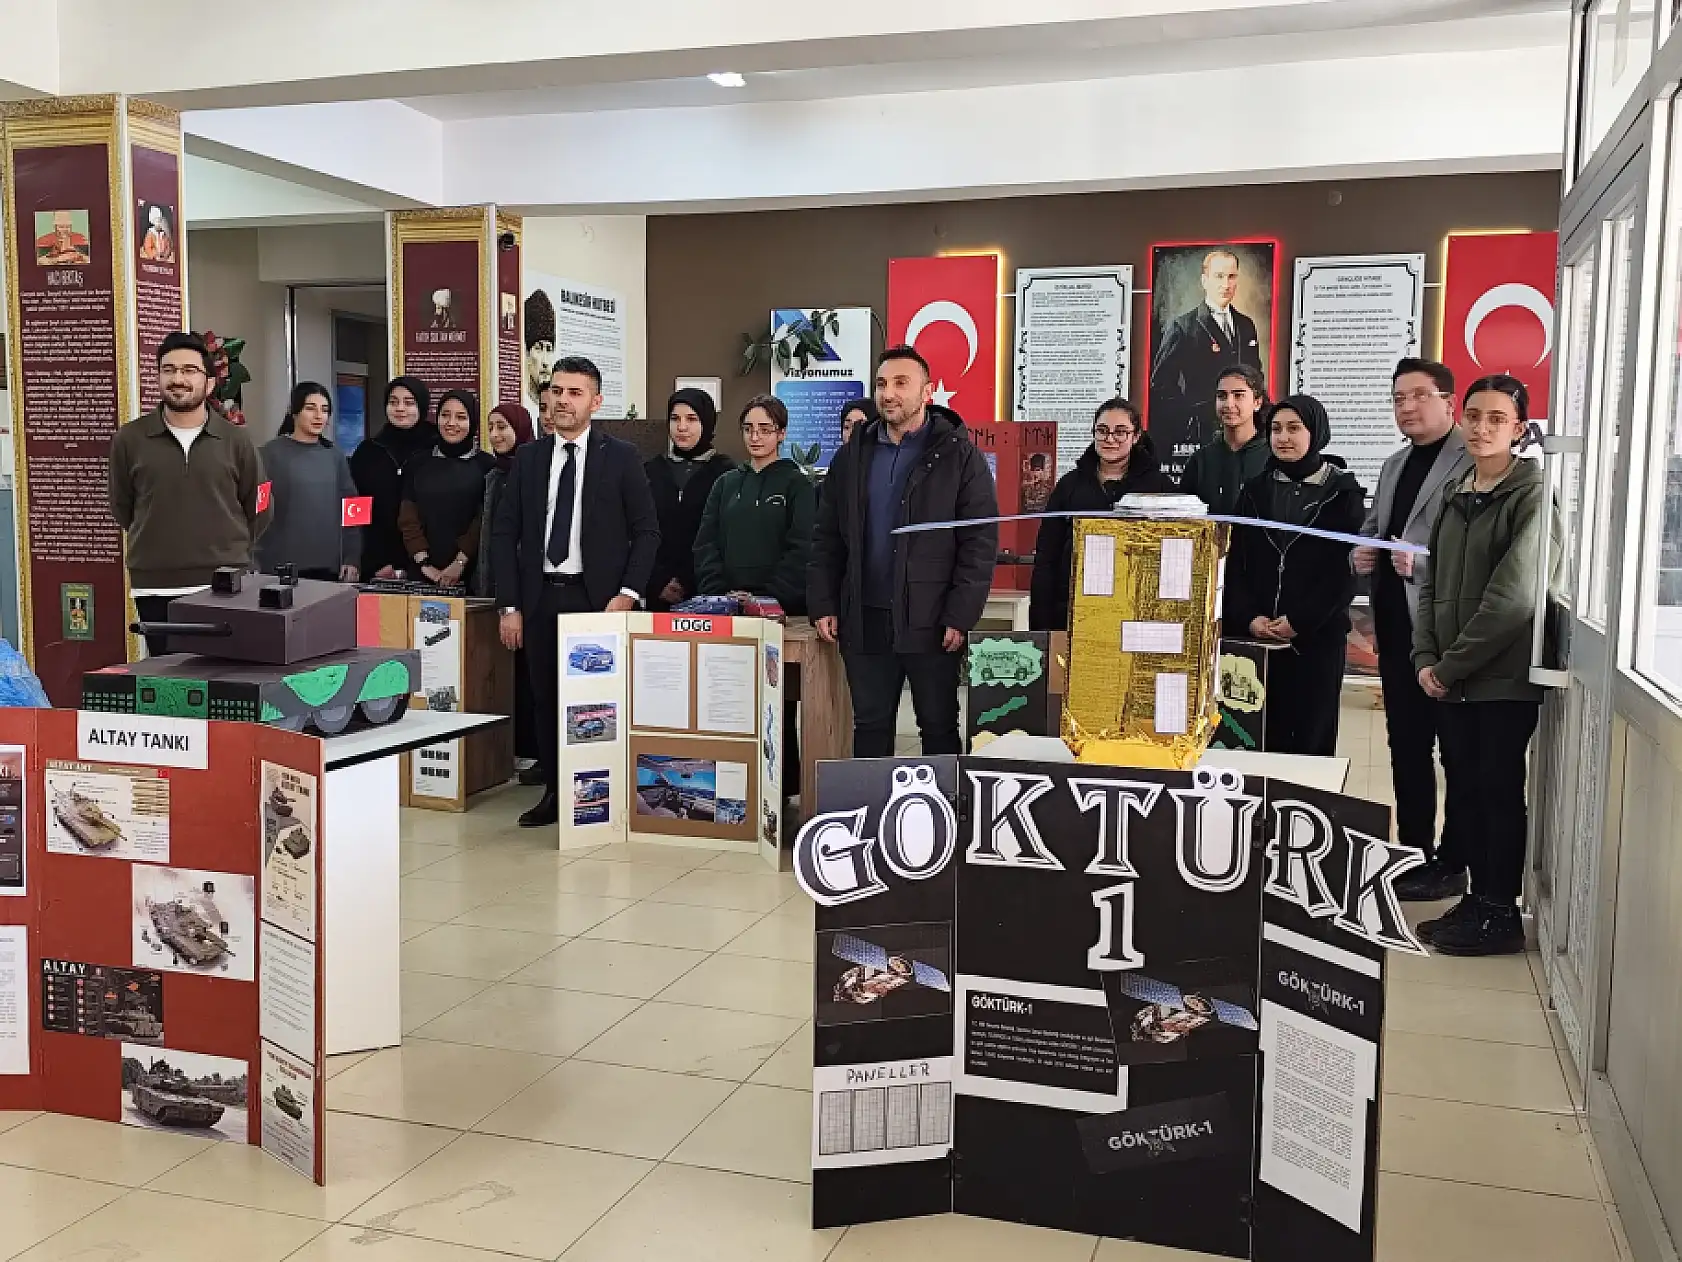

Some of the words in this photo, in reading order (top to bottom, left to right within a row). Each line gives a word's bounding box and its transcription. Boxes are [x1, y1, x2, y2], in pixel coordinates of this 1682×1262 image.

[674, 619, 711, 632] TOGG
[88, 728, 137, 748] ALTAY
[141, 732, 189, 752] TANKI
[793, 764, 1432, 957] GÖKTÜRK
[1088, 883, 1145, 970] 1
[43, 960, 87, 975] ALTAY
[971, 994, 1033, 1015] GÖKTÜRK-1
[846, 1061, 930, 1084] PANELLER
